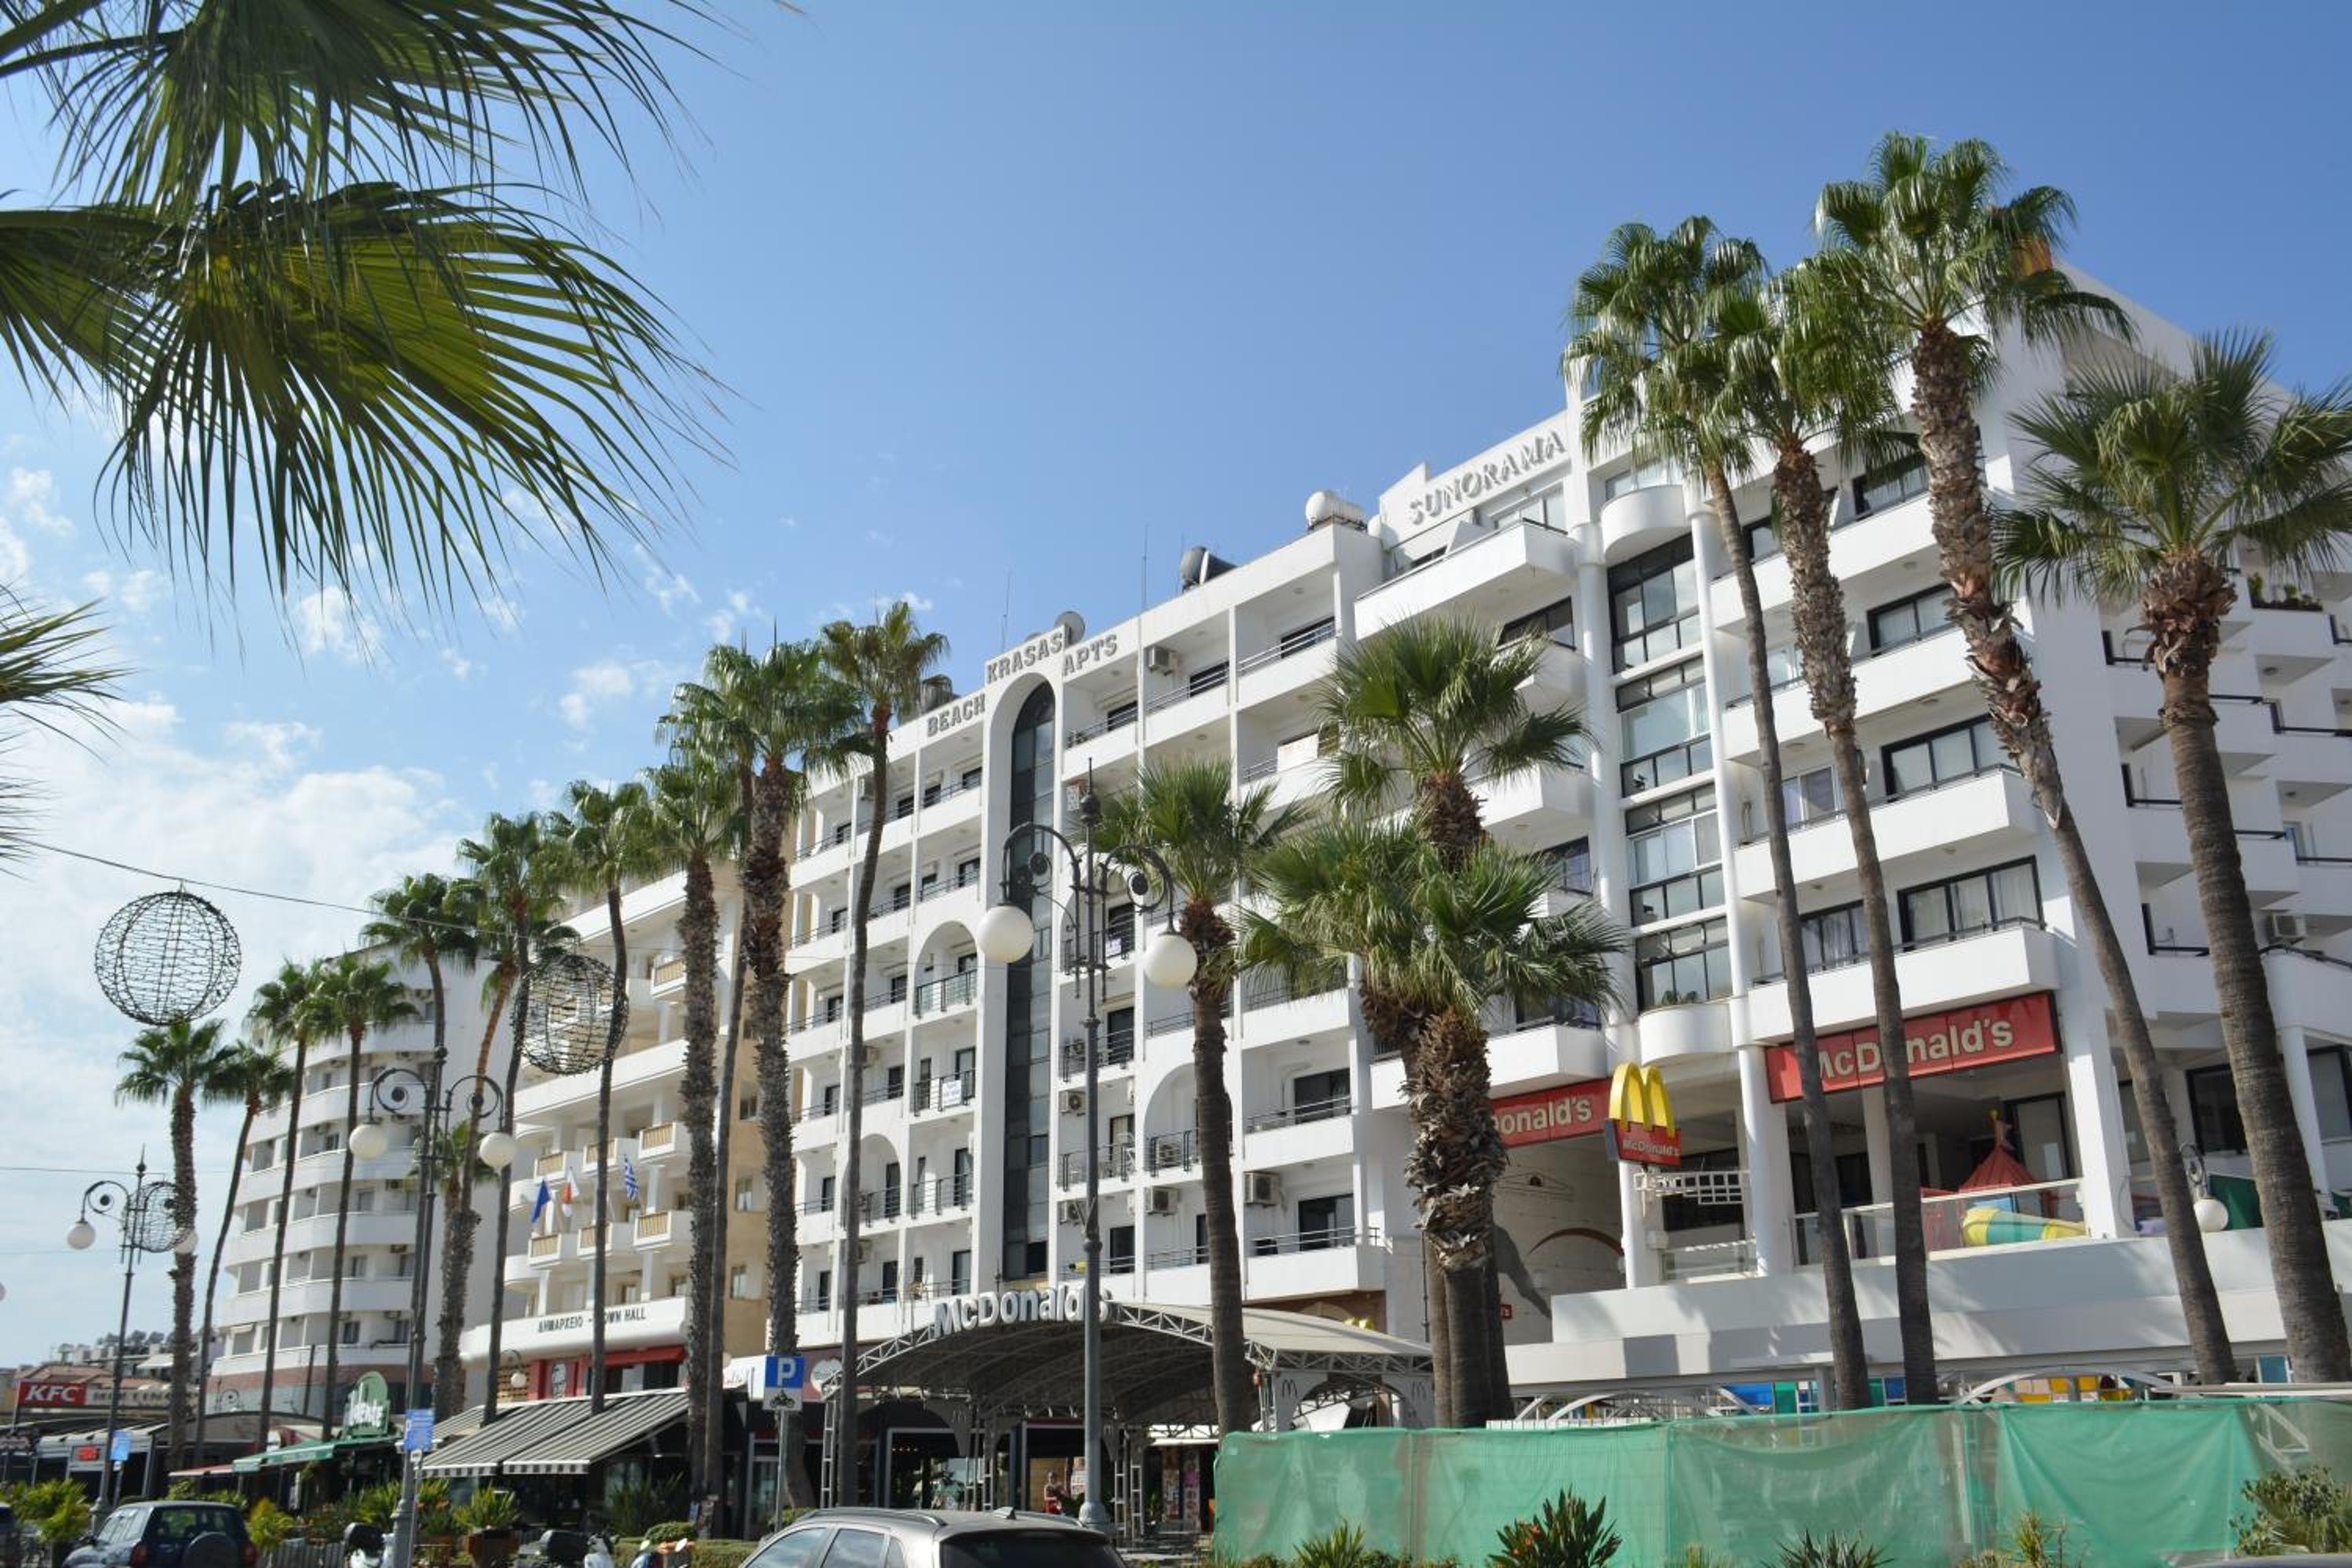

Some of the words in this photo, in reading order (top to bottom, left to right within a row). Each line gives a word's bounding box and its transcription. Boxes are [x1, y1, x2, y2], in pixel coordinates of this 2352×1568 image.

[1410, 431, 1567, 526] SUNORAMA
[927, 693, 985, 738] BEACH
[987, 632, 1062, 684] KRASAS
[1062, 634, 1117, 677] APTS
[1817, 1018, 2013, 1080] McDnald's
[1491, 1097, 1592, 1136] onald's
[1622, 1138, 1679, 1157] McDonald's
[601, 1309, 622, 1325] OWN
[623, 1307, 646, 1322] HALL
[777, 1357, 797, 1385] P
[24, 1385, 77, 1402] KFC
